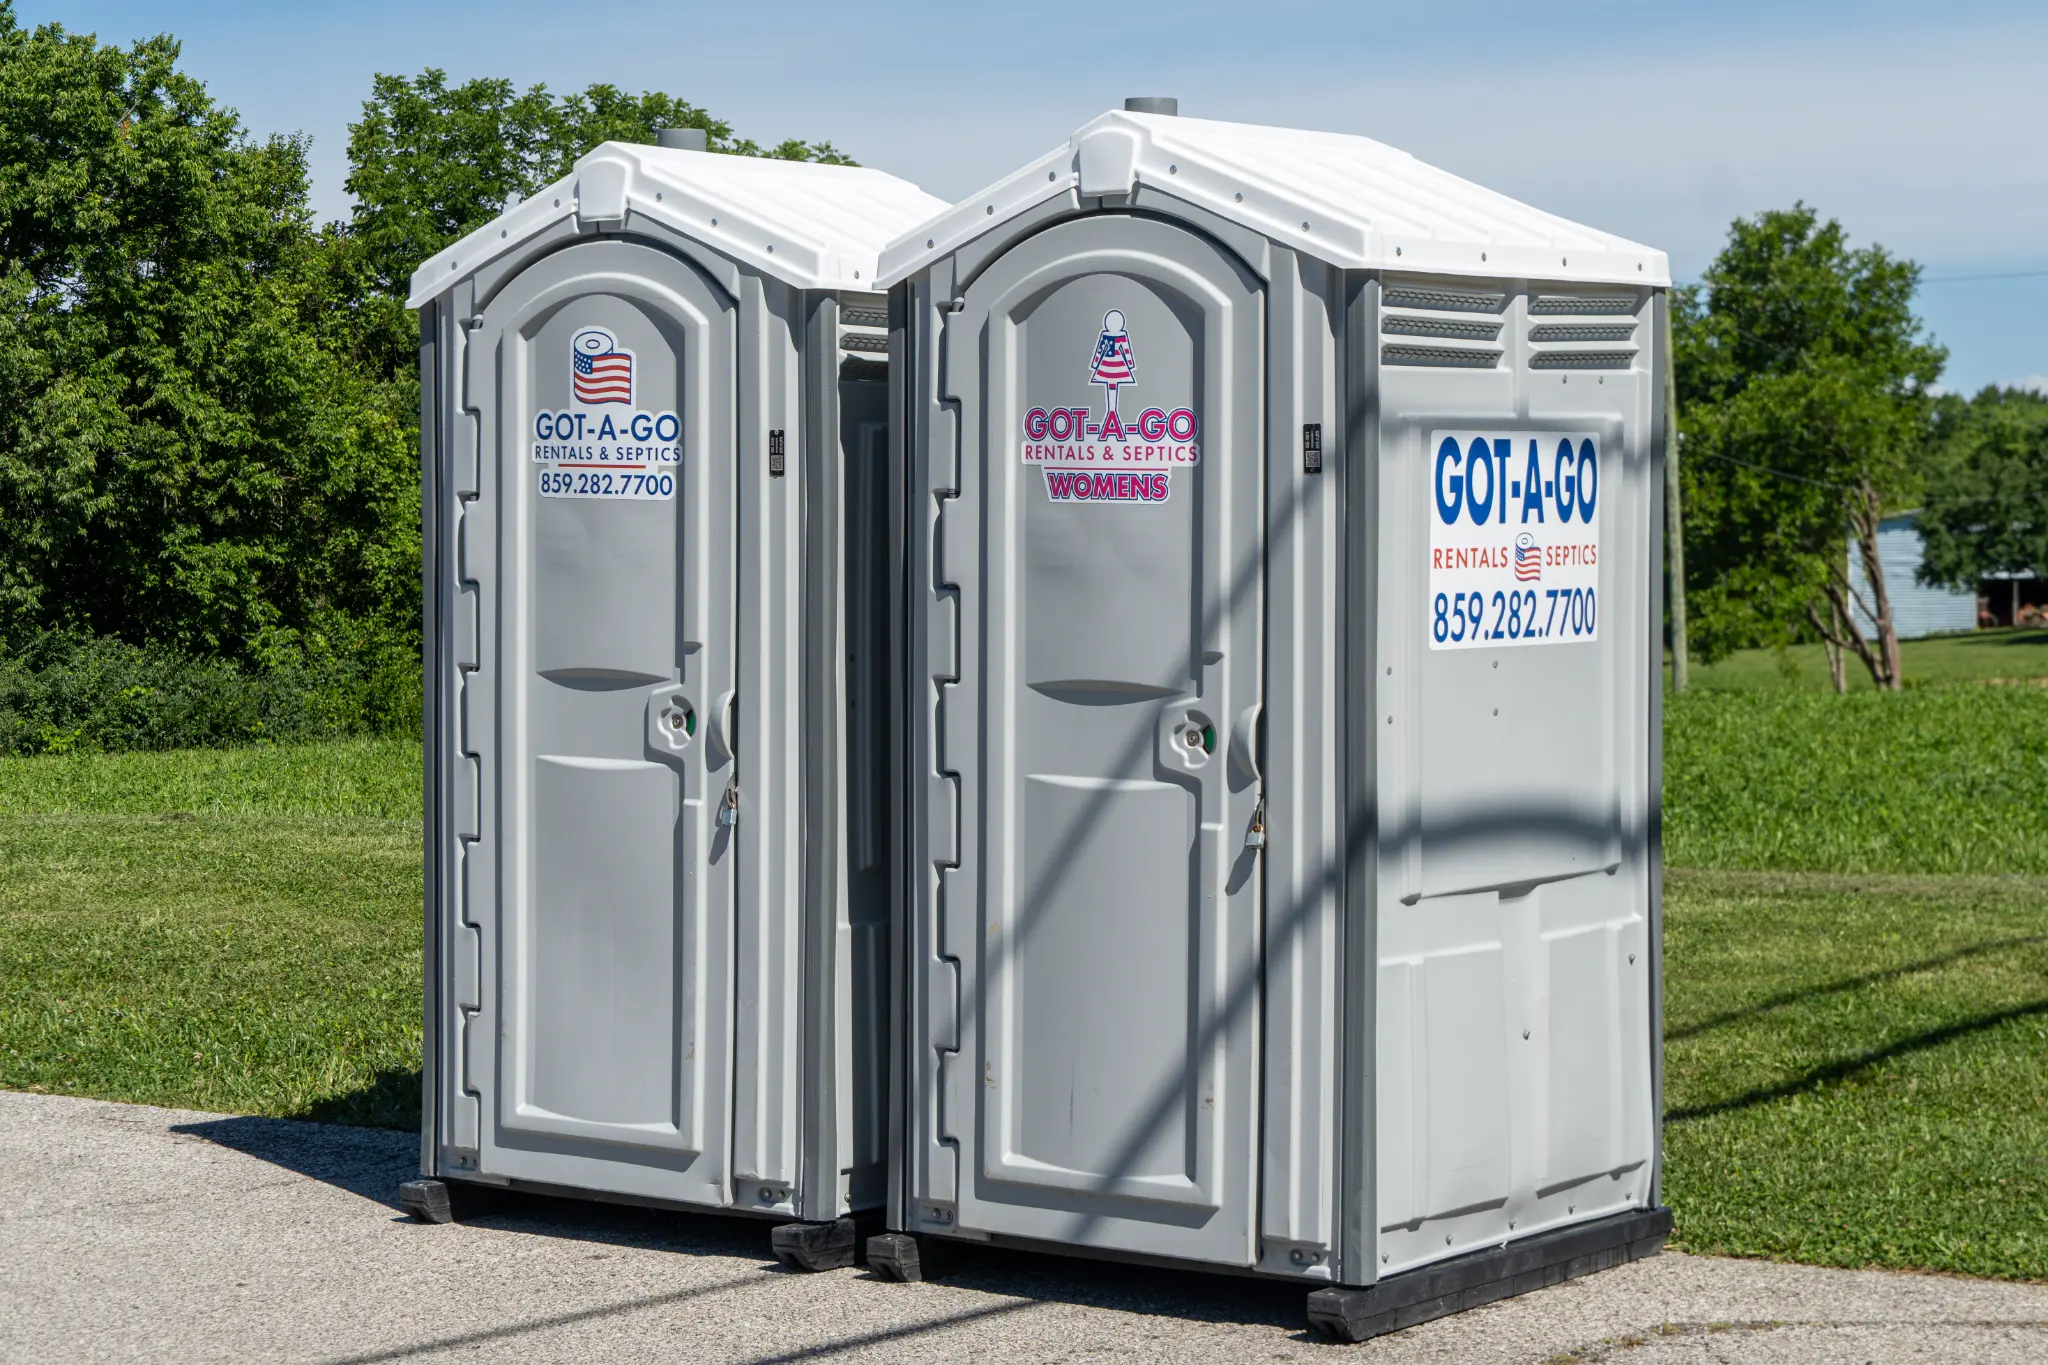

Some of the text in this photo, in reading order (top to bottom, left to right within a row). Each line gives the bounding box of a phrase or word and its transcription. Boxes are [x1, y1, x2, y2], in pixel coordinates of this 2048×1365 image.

[536, 413, 679, 442] GOT-A-GO
[1024, 407, 1198, 443] GOT-A-GO
[535, 445, 681, 462] RENTALS & SEPTICS
[1025, 445, 1197, 462] RENTALS & SEPTICS
[541, 473, 673, 496] 859.282.7700
[1047, 472, 1169, 501] WOMENS
[1435, 436, 1598, 526] GOT-A-GO
[1433, 544, 1597, 569] RENTALS SEPTICS
[1433, 587, 1596, 643] 859.282.7700
